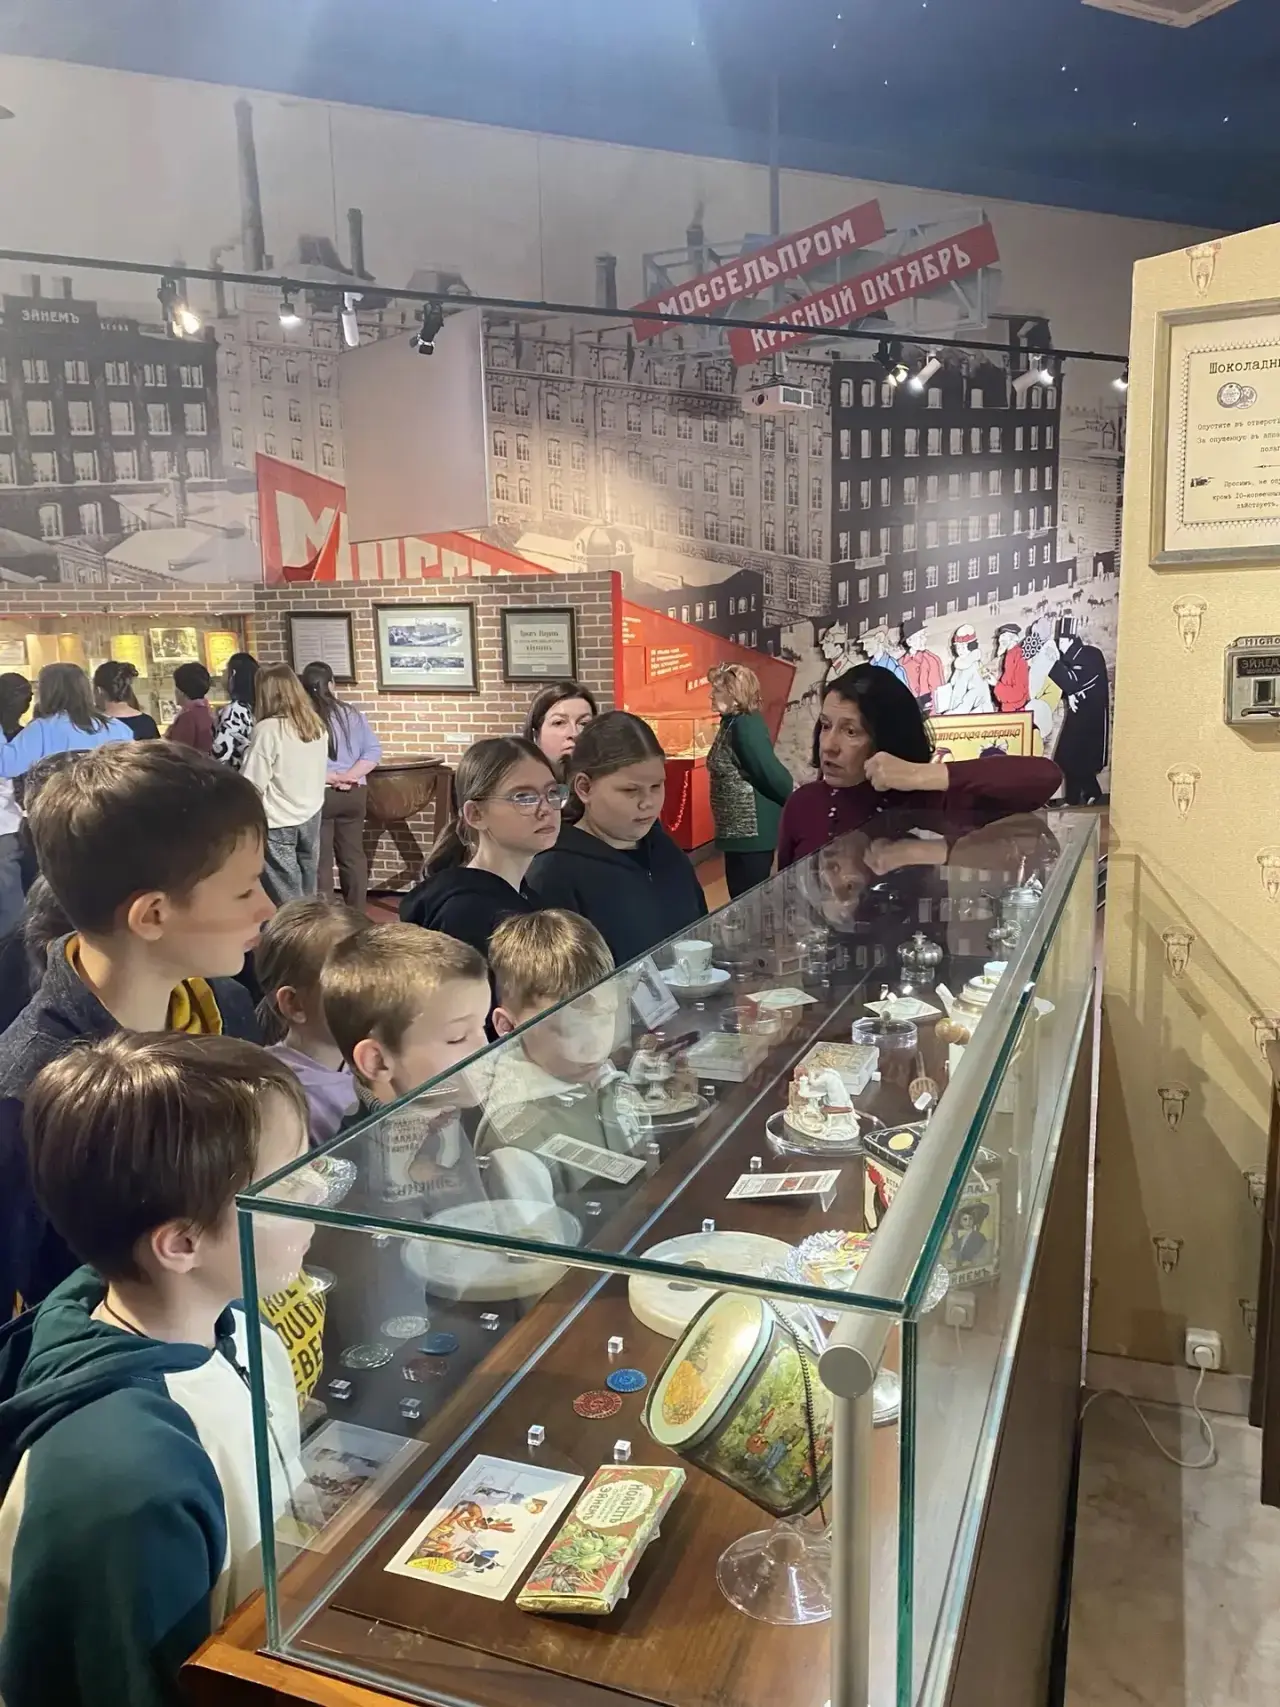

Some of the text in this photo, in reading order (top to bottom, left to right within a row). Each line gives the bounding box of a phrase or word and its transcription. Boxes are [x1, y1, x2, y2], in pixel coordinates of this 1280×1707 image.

[658, 218, 856, 324] МОССЕЛЬПРОМ
[751, 243, 971, 352] КРАСНЫЙ ОКТЯБРЬ
